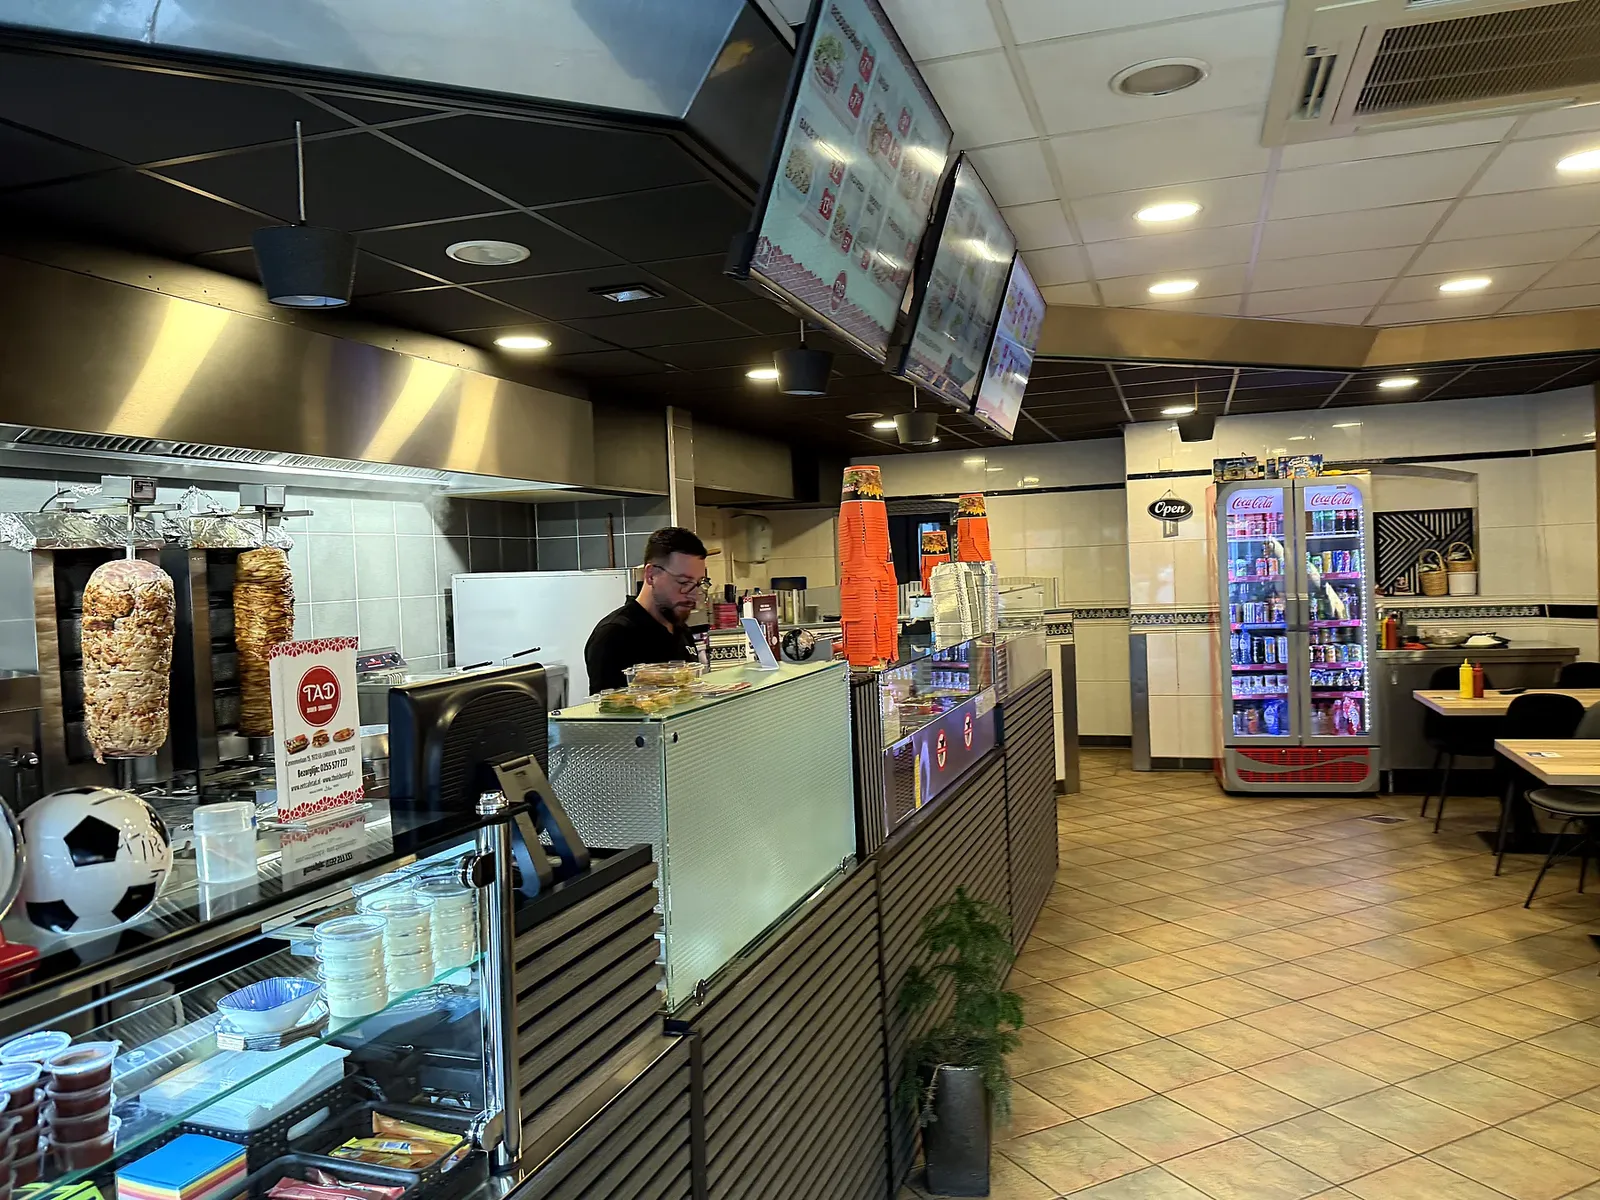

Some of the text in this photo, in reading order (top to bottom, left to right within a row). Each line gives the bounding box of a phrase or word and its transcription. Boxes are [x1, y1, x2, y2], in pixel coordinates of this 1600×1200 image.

[1232, 495, 1274, 510] Coca-Cola
[1311, 491, 1354, 507] Coca-Cola
[1154, 501, 1186, 517] Open
[302, 682, 336, 703] TAD
[320, 761, 332, 772] 0255
